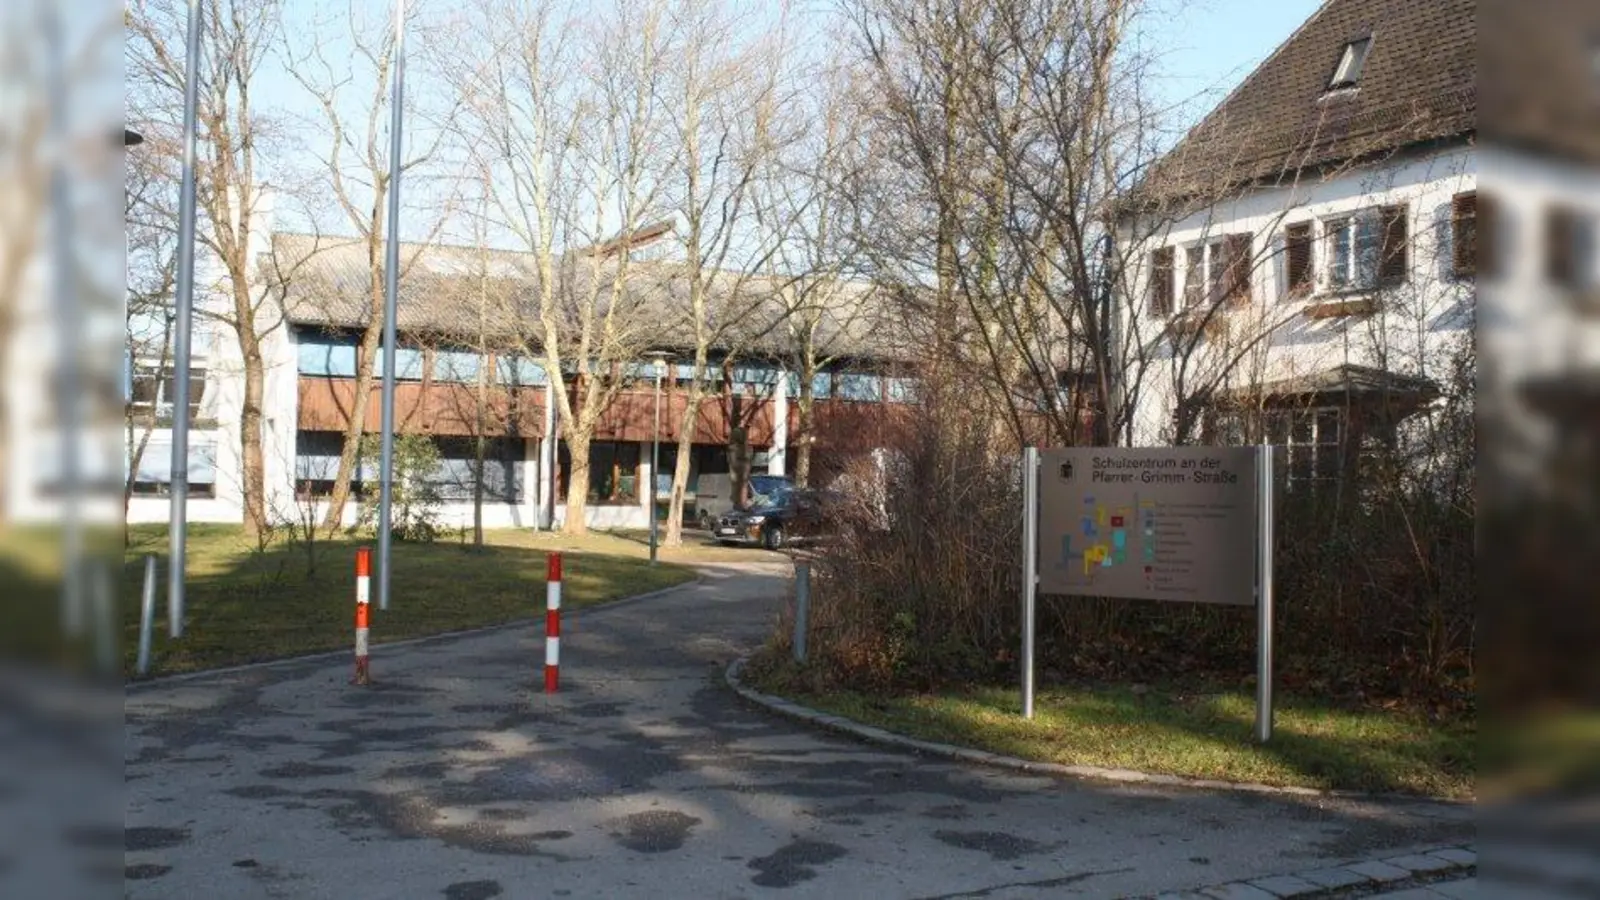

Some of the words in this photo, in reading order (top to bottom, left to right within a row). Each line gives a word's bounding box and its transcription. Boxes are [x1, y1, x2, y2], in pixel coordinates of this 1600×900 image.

[1092, 456, 1176, 469] Schulzentrum
[1181, 459, 1196, 469] an
[1200, 456, 1221, 469] der
